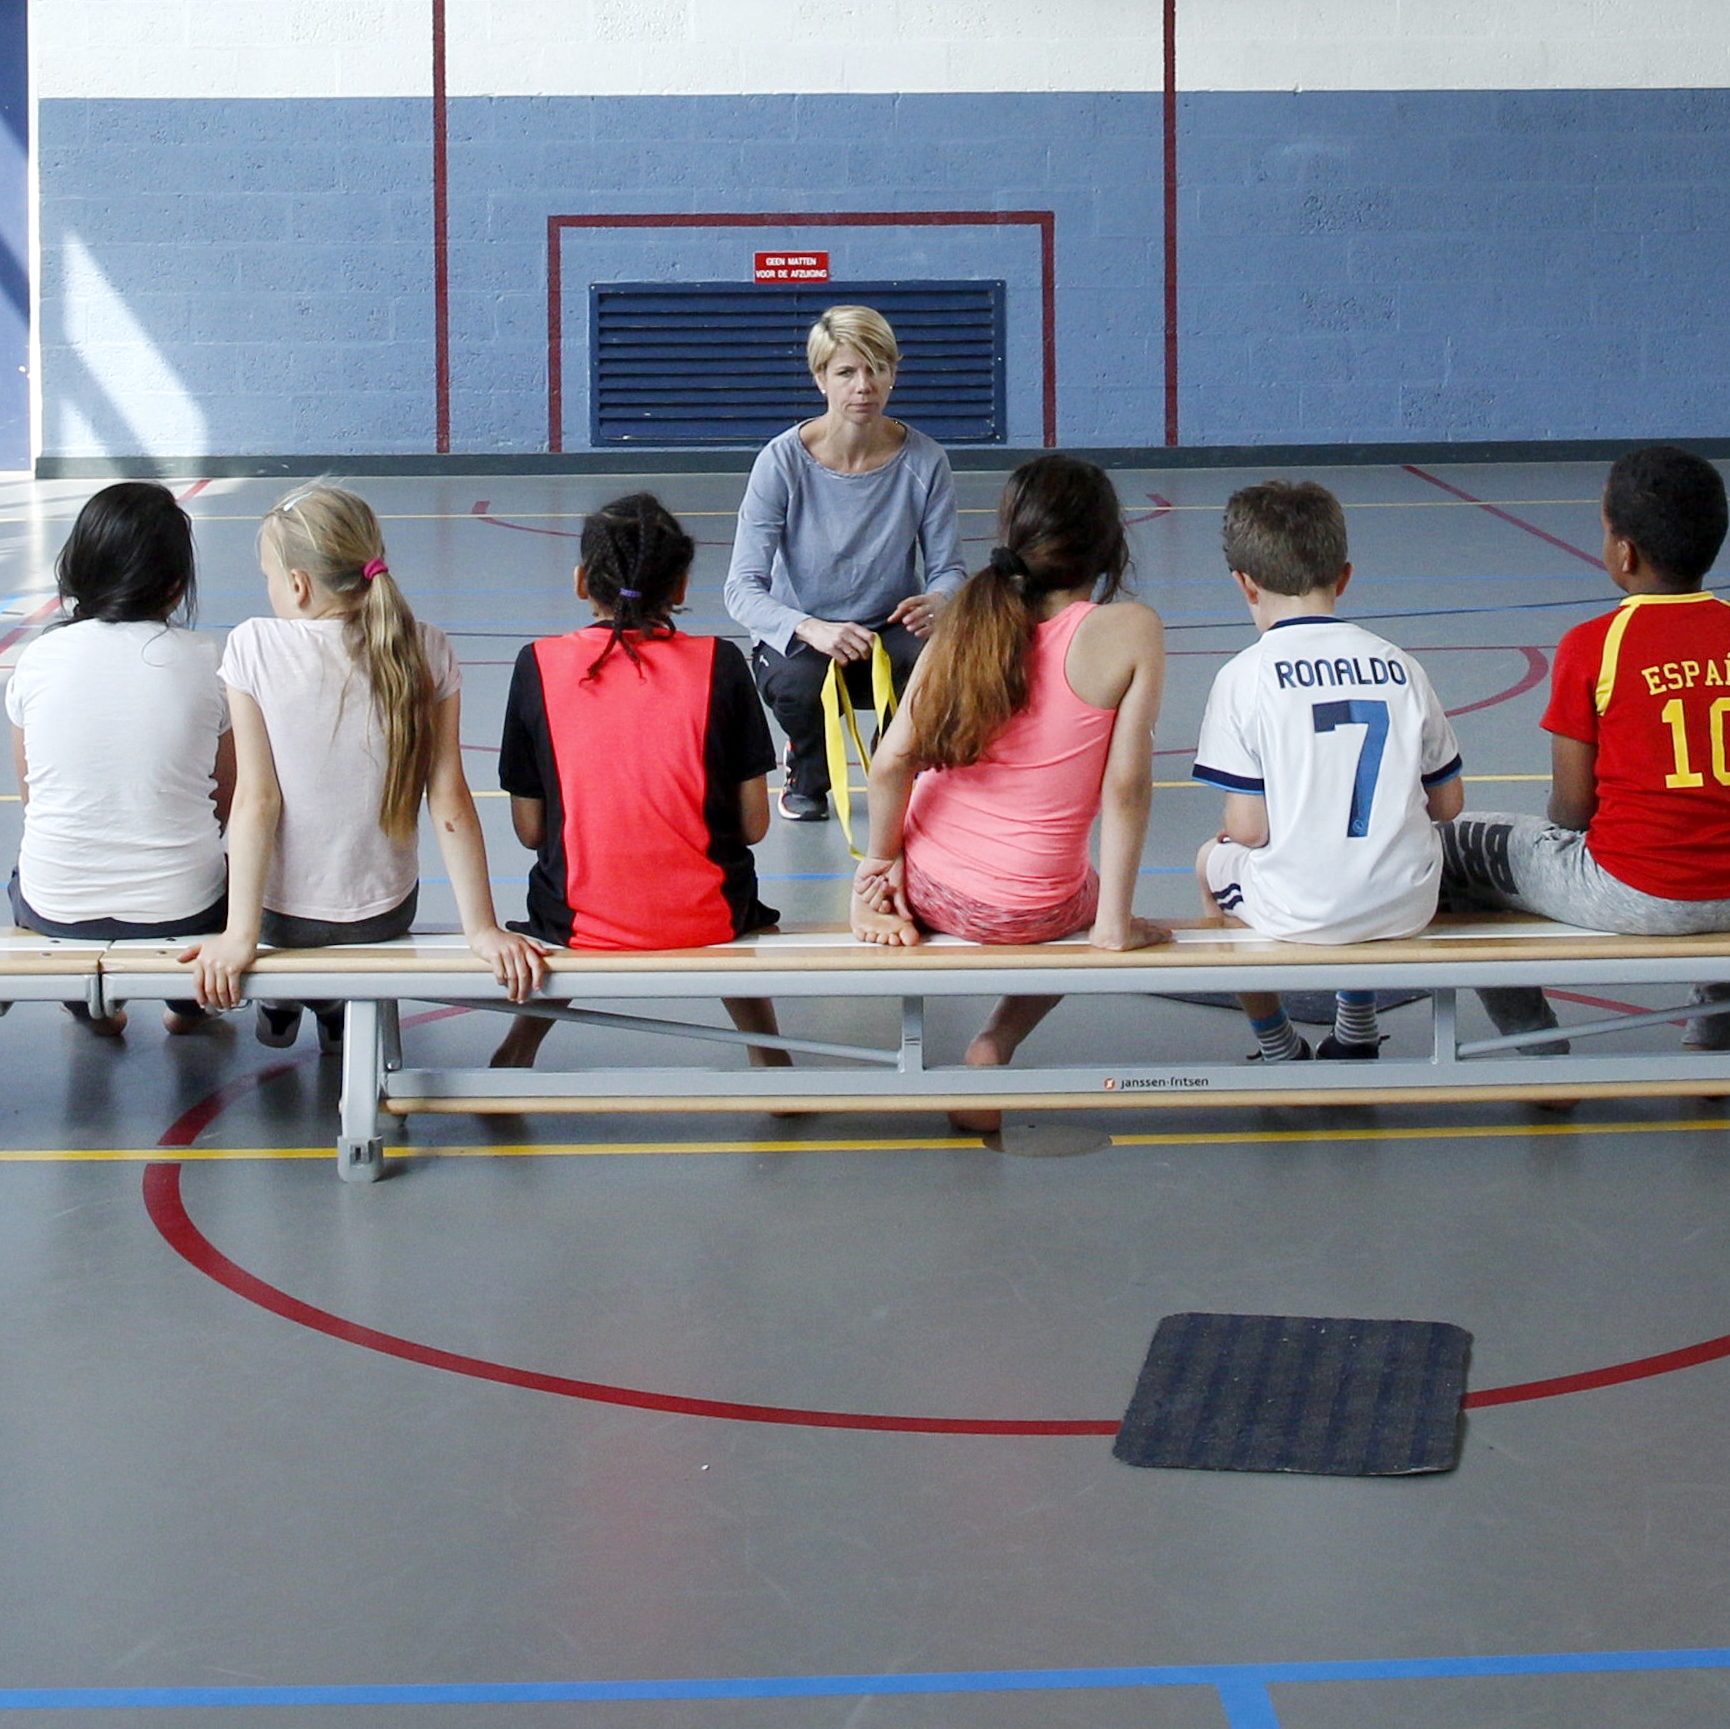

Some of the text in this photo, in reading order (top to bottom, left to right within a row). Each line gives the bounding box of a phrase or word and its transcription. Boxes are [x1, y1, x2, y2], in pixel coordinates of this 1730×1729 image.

[766, 257, 817, 266] GEEN MATTEN
[755, 269, 776, 278] VOOR
[777, 269, 788, 278] DE
[1274, 657, 1407, 689] RONALDO
[1312, 699, 1390, 837] 7
